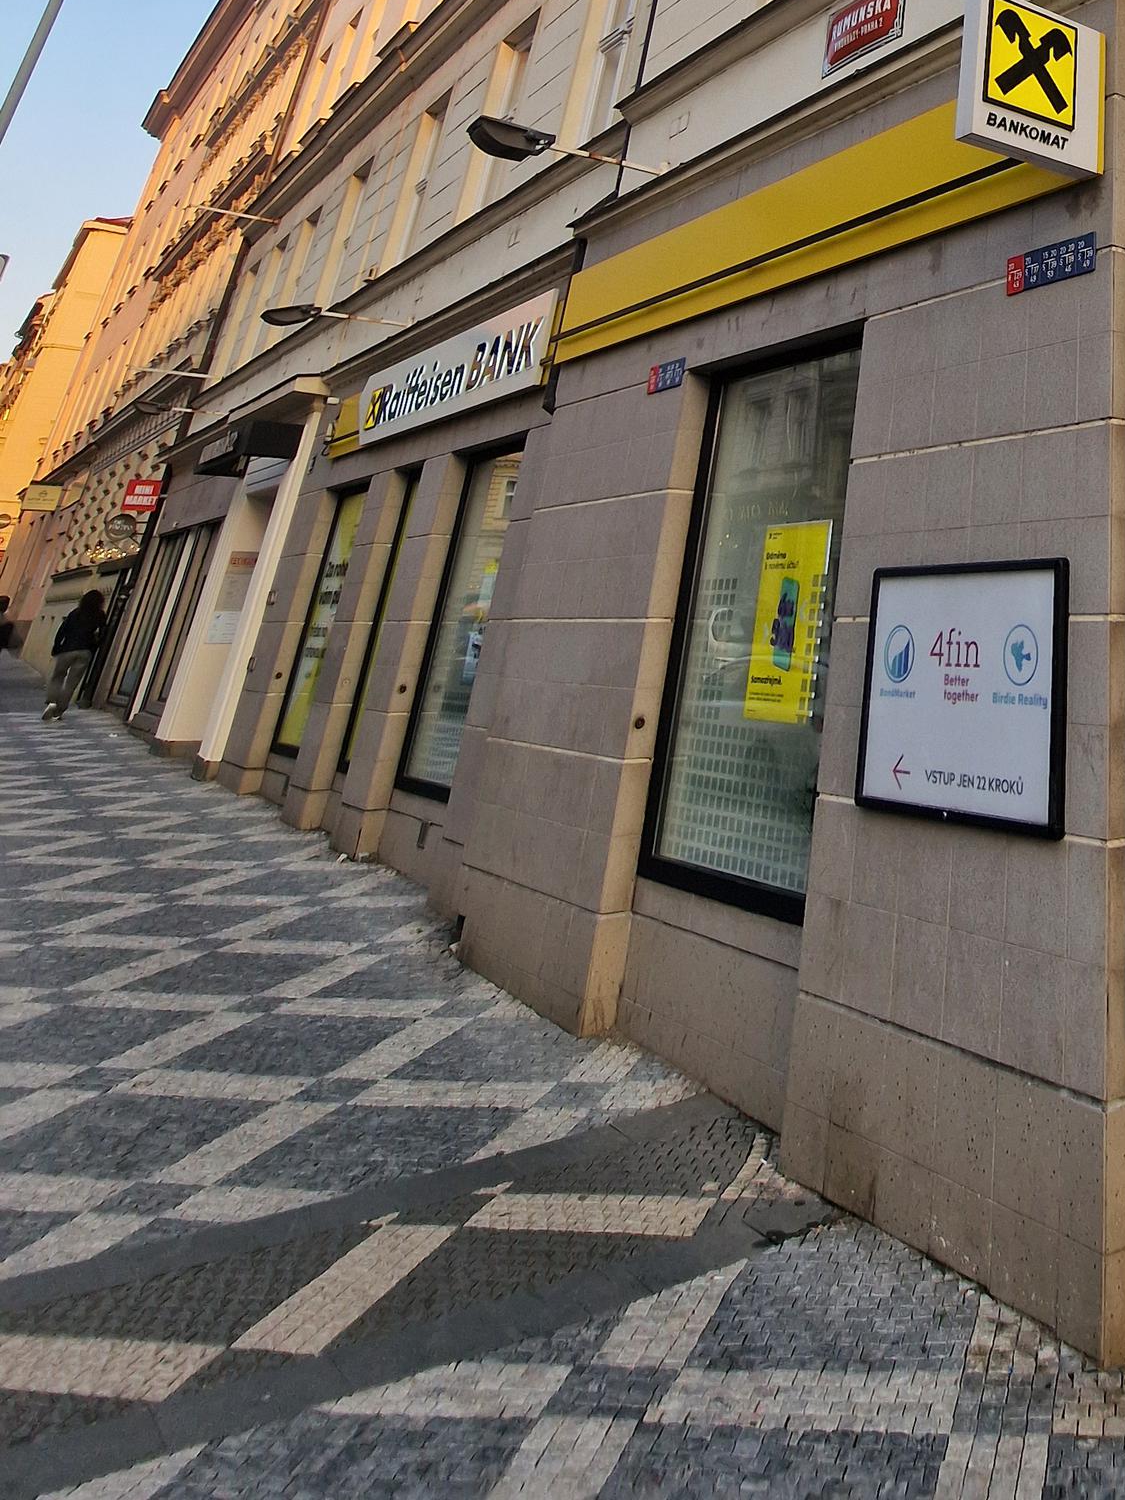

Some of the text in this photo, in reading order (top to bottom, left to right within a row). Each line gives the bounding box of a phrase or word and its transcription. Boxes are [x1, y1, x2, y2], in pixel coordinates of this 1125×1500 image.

[985, 111, 1069, 151] BANKOMAT
[377, 315, 544, 425] Raiffeisen BANK
[124, 495, 159, 506] MARKET
[929, 627, 981, 668] 4fin
[943, 674, 969, 687] Better
[943, 690, 979, 706] together
[992, 691, 1049, 710] Birdie Reality
[924, 769, 1024, 796] VSTUP JEN 22 KROKŮ
